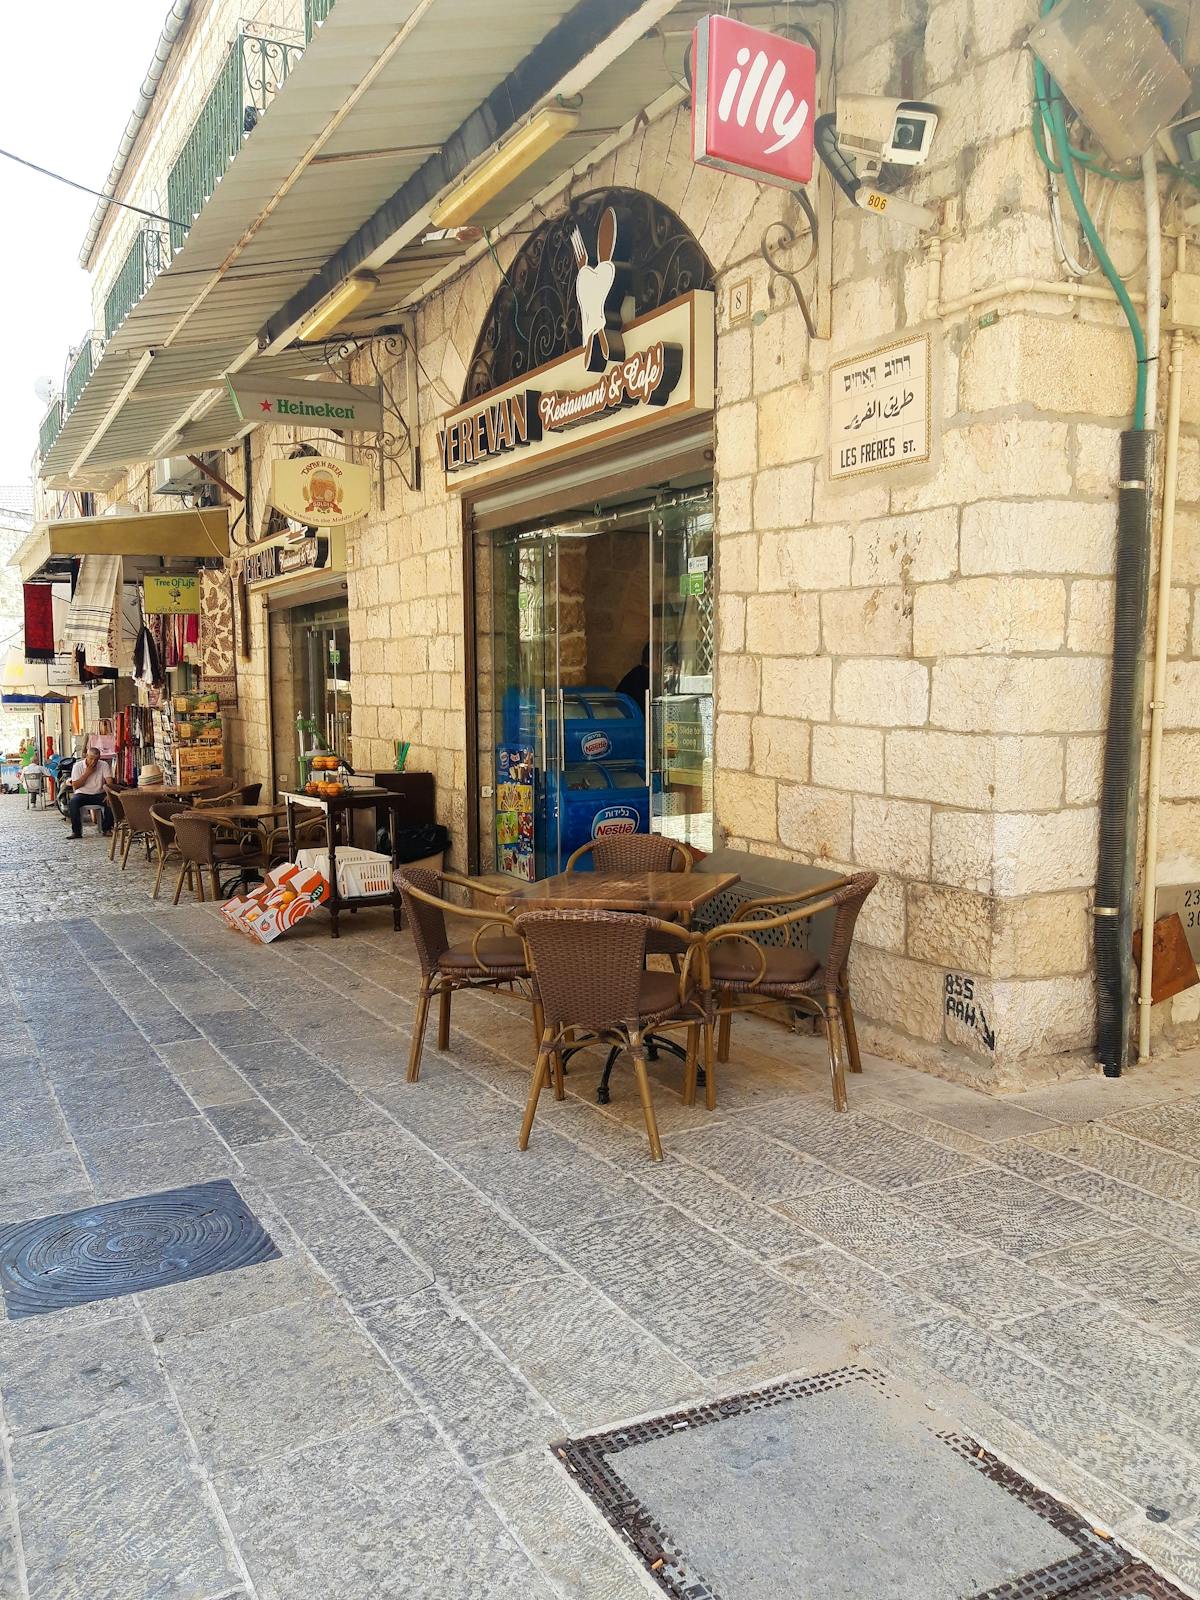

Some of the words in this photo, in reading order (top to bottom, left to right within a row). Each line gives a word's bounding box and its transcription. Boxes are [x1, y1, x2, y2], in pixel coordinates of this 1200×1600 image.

[718, 48, 809, 154] illy
[868, 195, 887, 210] 806
[735, 291, 742, 310] 8
[277, 399, 355, 419] Heineken
[436, 390, 528, 471] YEREVAN
[541, 381, 606, 424] Restaurant
[608, 370, 623, 400] &
[841, 447, 857, 469] LES
[903, 440, 916, 454] ST.
[301, 461, 326, 475] TAYBEH
[328, 462, 343, 478] BEER
[154, 578, 170, 586] Tree
[182, 578, 195, 588] Life
